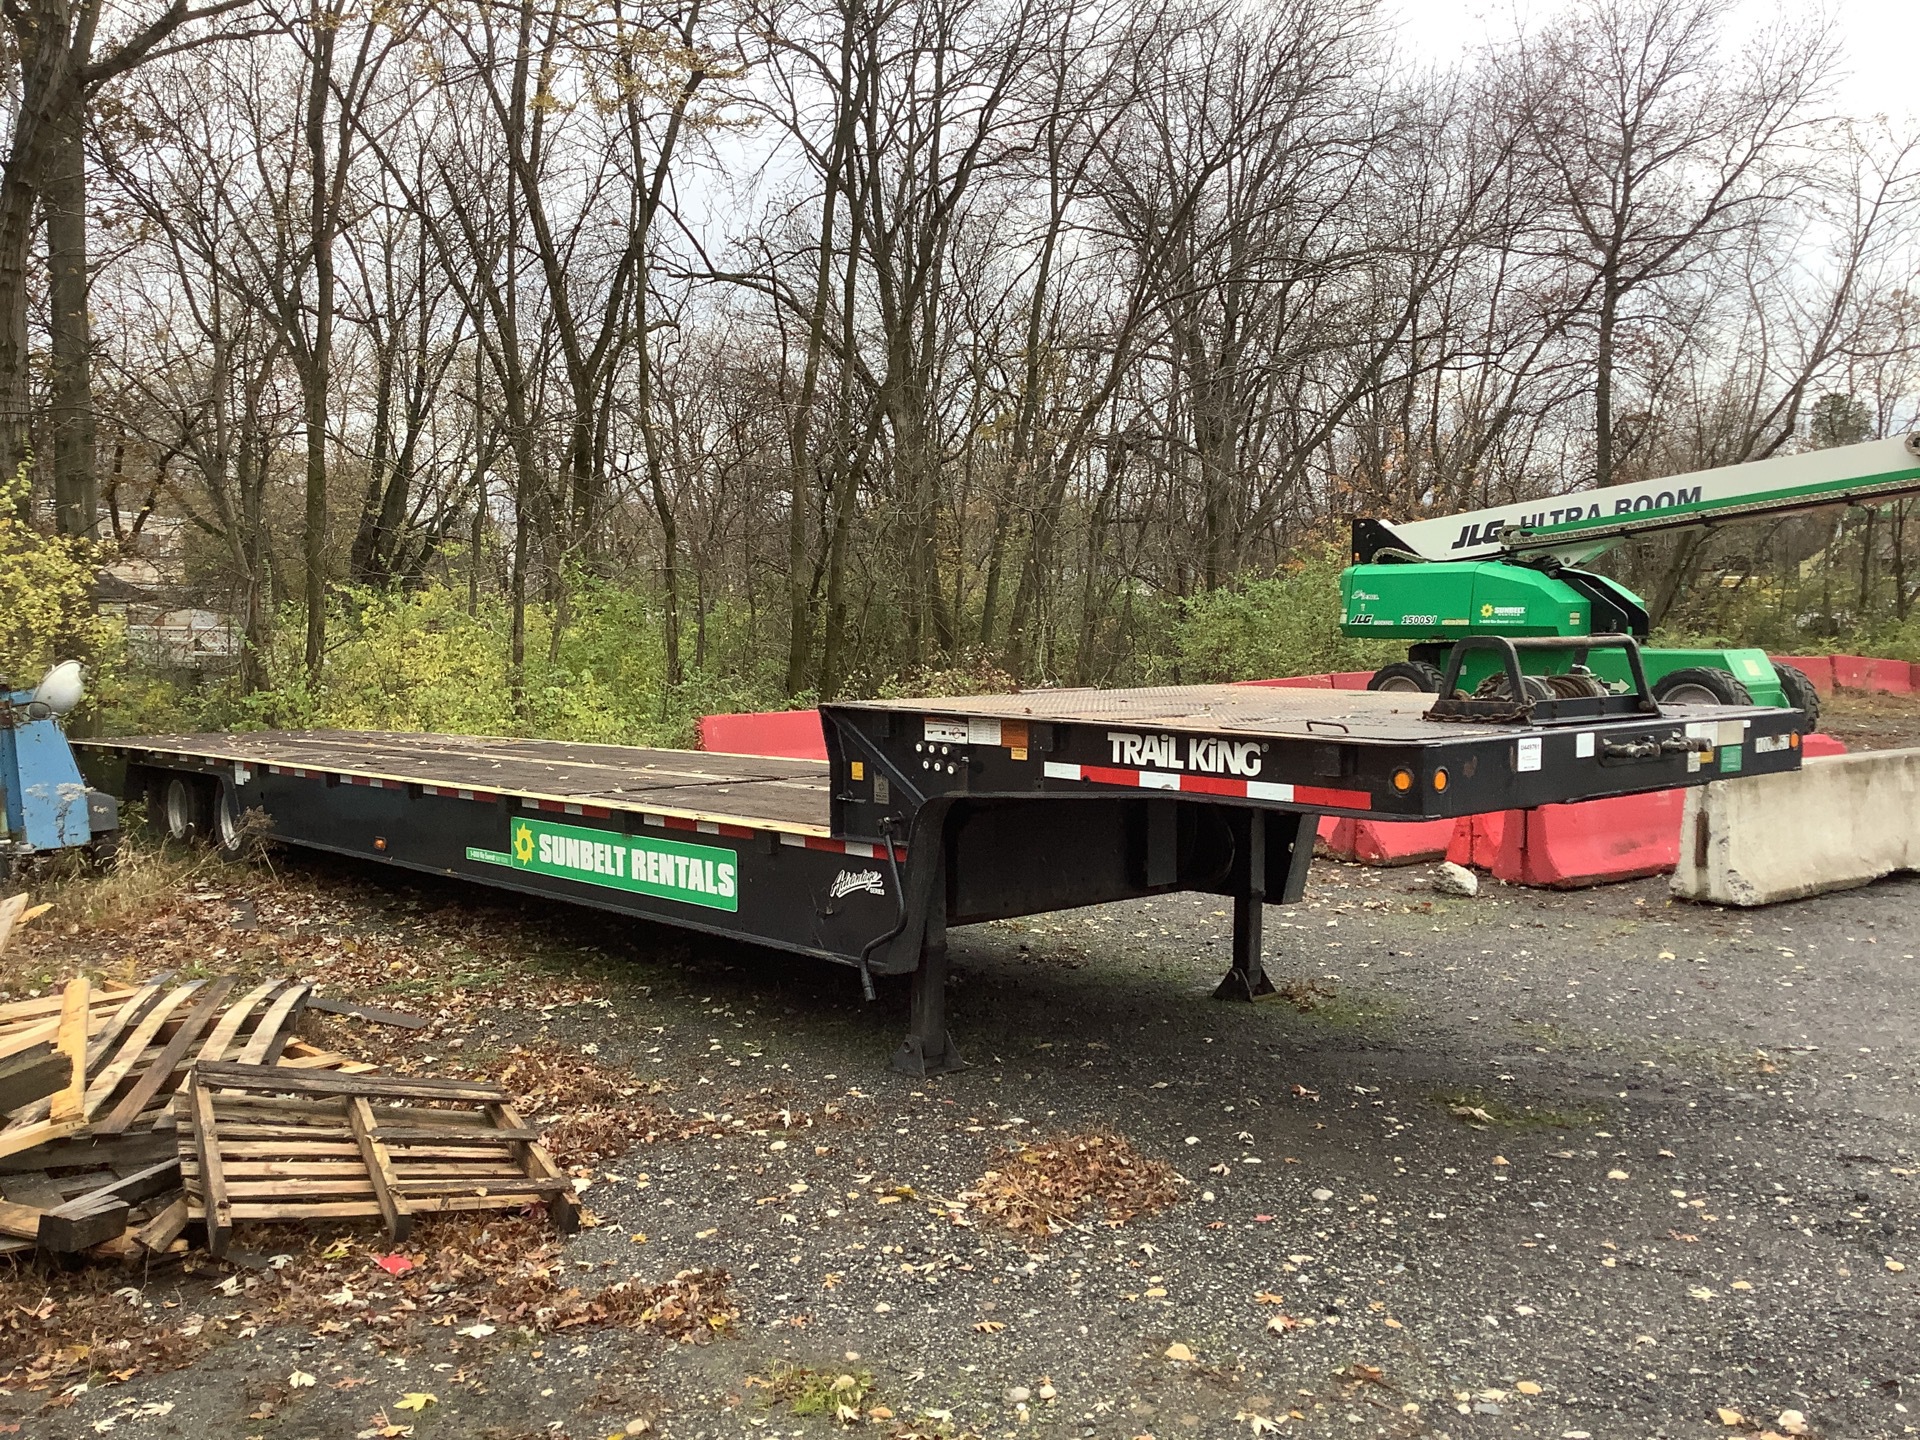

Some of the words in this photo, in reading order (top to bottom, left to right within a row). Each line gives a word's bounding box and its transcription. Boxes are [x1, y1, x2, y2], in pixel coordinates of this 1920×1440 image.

[1451, 519, 1505, 549] JLG
[1350, 614, 1373, 624] JLG
[1401, 614, 1438, 625] 1500SJ
[1494, 606, 1526, 614] SUNBELT
[539, 833, 626, 878] SUNBELT
[631, 848, 735, 898] RENTALS
[830, 868, 883, 898] Advantage
